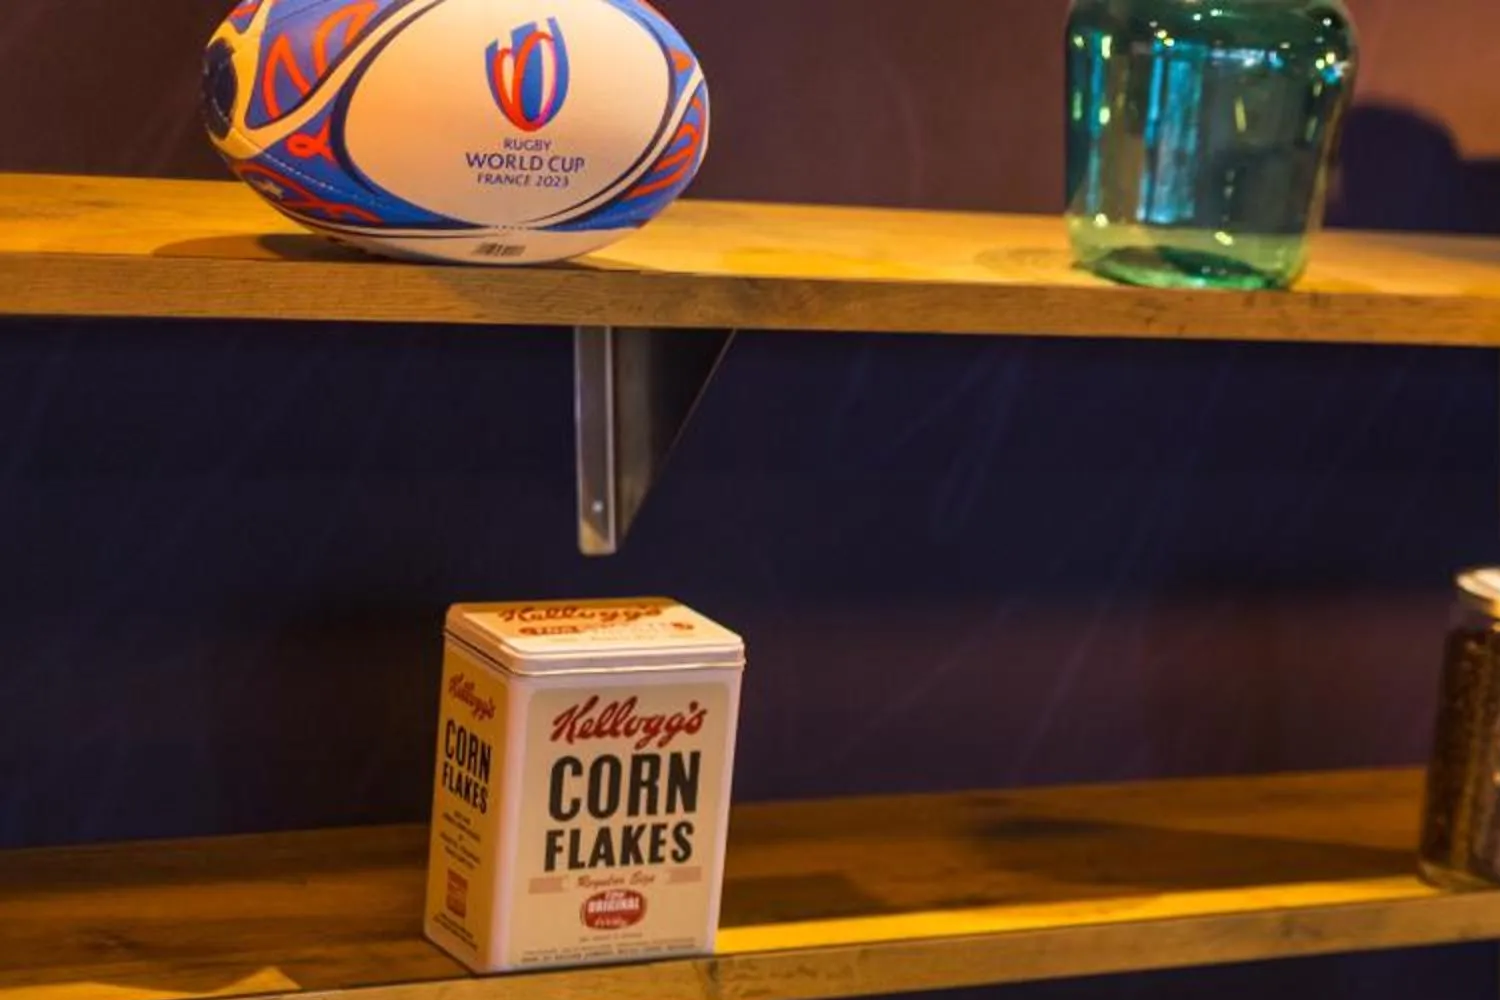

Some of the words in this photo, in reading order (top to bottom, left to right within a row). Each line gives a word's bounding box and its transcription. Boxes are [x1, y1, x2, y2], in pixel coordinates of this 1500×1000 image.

[465, 151, 544, 170] WORLD
[547, 154, 585, 173] CUP
[503, 138, 551, 151] RUGBY
[477, 173, 531, 187] FRANCE
[535, 175, 570, 188] 2023
[550, 695, 708, 749] Kellogg's
[445, 718, 492, 785] CORN
[442, 760, 488, 815] FLAKES
[548, 750, 702, 822] CORN
[544, 822, 694, 872] FLAKES
